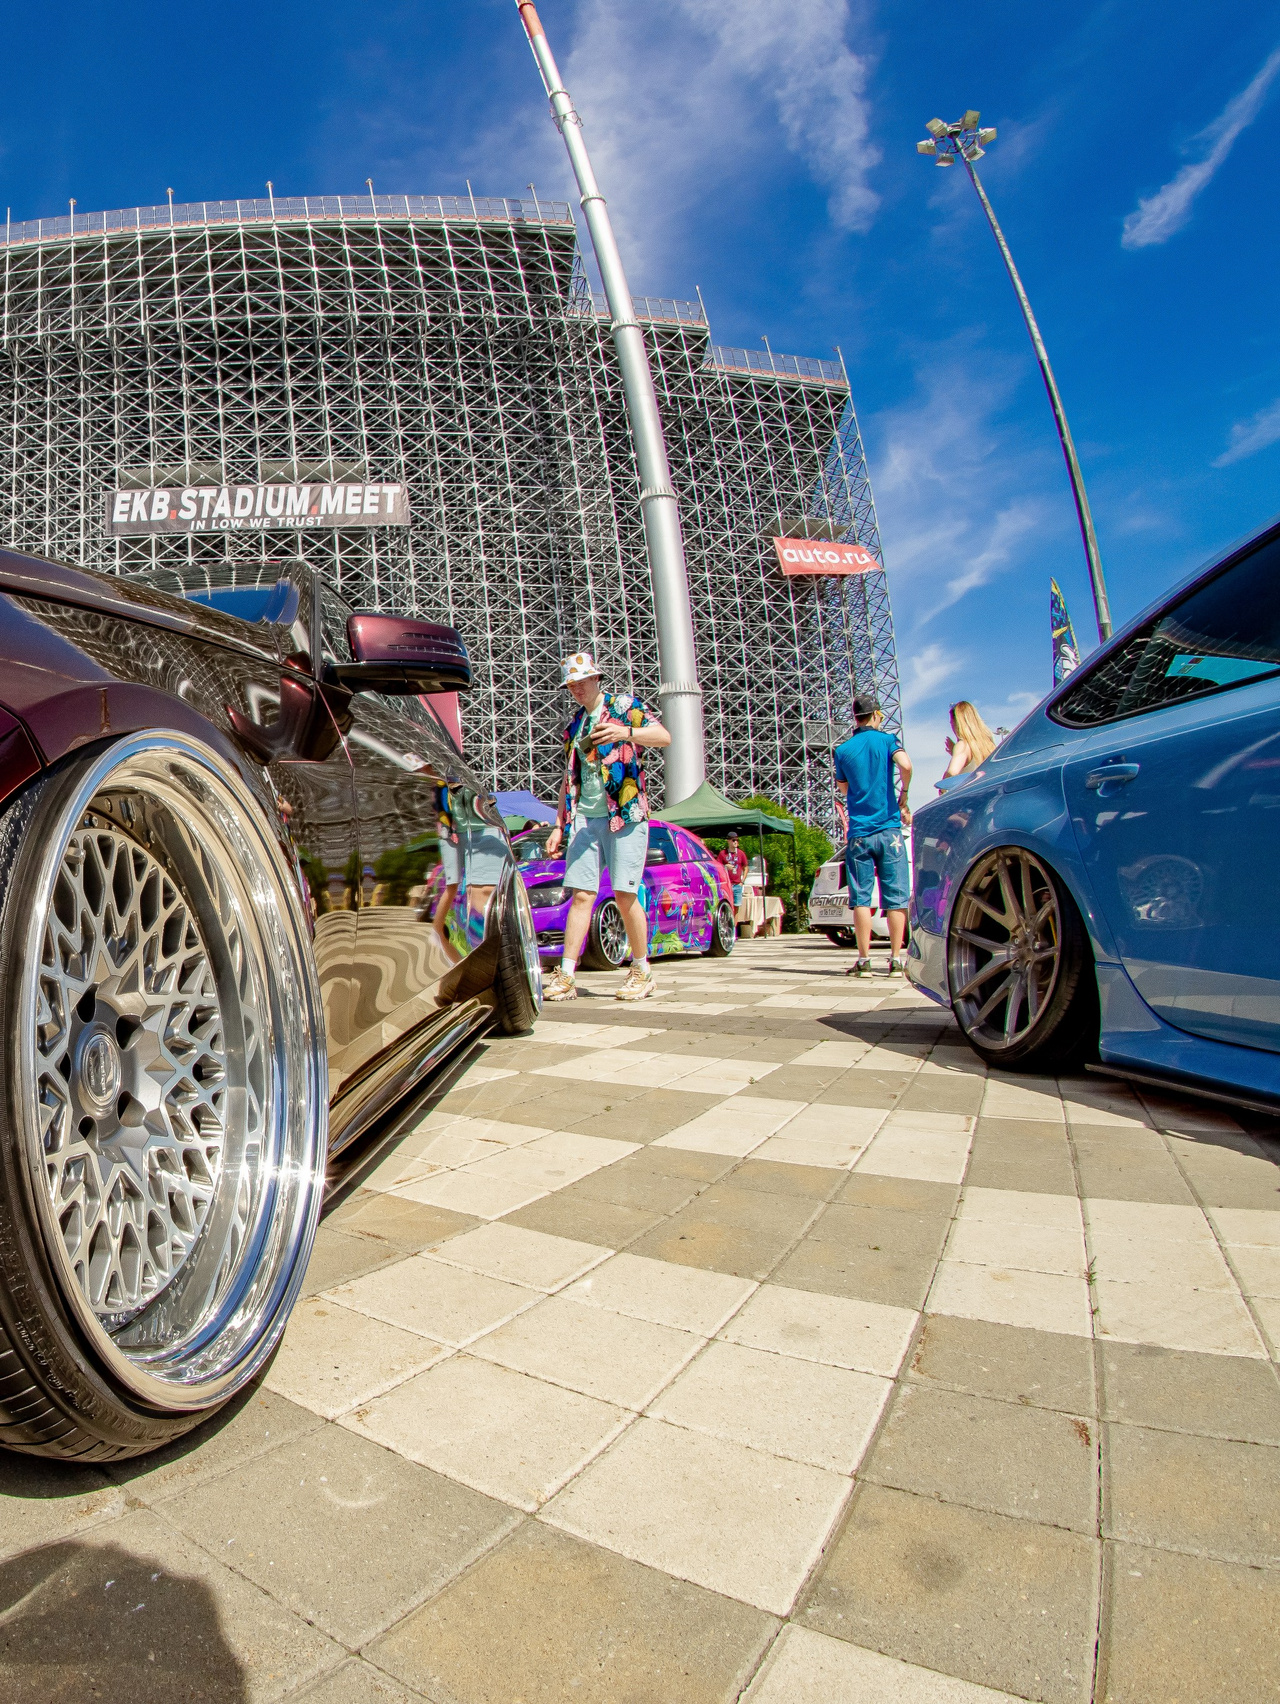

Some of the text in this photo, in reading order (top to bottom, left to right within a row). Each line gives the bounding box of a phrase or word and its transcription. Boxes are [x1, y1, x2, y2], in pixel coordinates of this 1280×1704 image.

[190, 515, 324, 531] IN LOW WE TRUST
[783, 548, 872, 565] auto.ru
